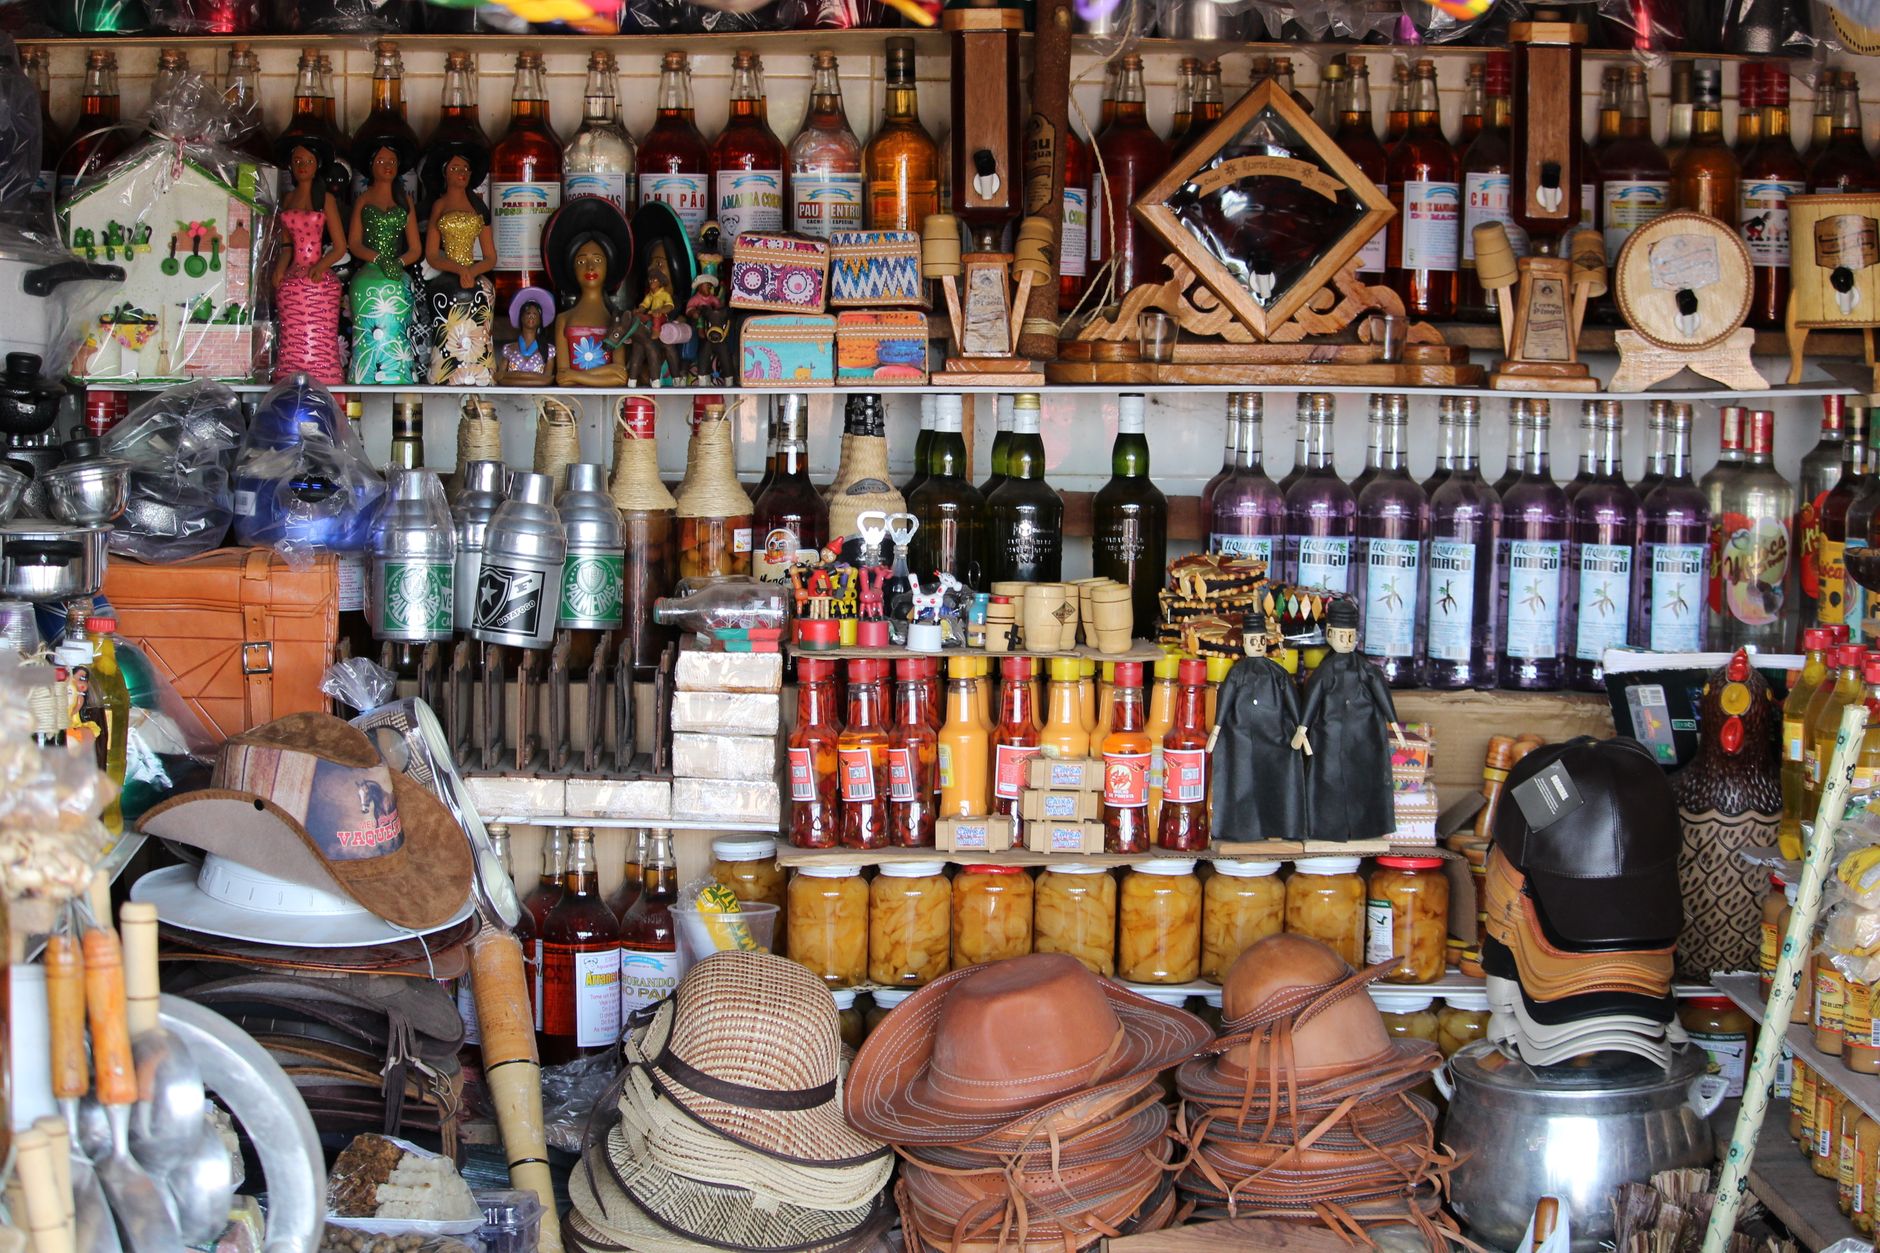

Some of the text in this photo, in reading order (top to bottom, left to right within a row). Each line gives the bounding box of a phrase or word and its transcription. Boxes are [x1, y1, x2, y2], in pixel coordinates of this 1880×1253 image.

[799, 203, 819, 216] PAU
[1302, 552, 1347, 567] MAGU
[1371, 553, 1416, 568] MAGU
[1431, 557, 1472, 572] MAGU
[1513, 556, 1558, 570] MAGU
[1584, 559, 1628, 573] MAGU
[1655, 560, 1700, 573] MAGU
[566, 582, 616, 617] PALMEIRAS
[497, 599, 536, 627] BOTAFOGO
